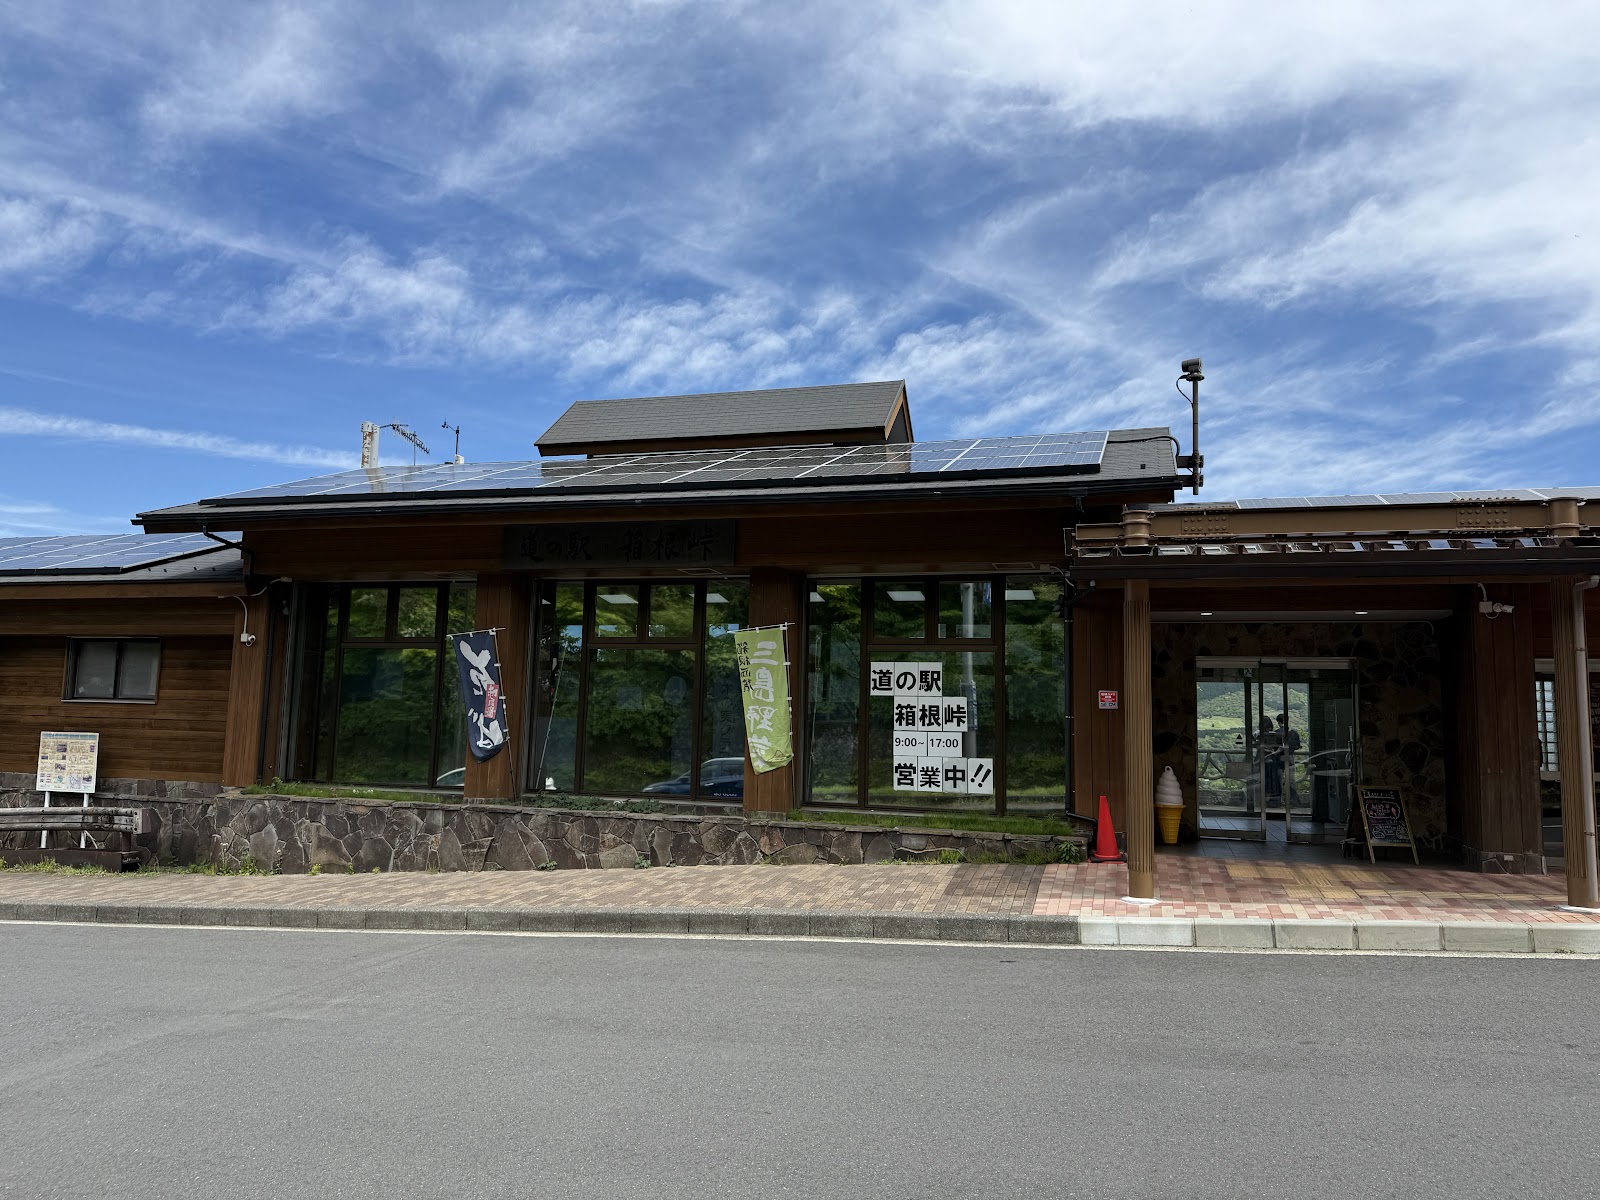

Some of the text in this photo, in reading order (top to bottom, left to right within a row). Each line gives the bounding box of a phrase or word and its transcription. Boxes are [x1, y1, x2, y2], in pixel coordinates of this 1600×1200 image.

[871, 669, 942, 692] 道の駅
[894, 703, 967, 727] 箱根峠
